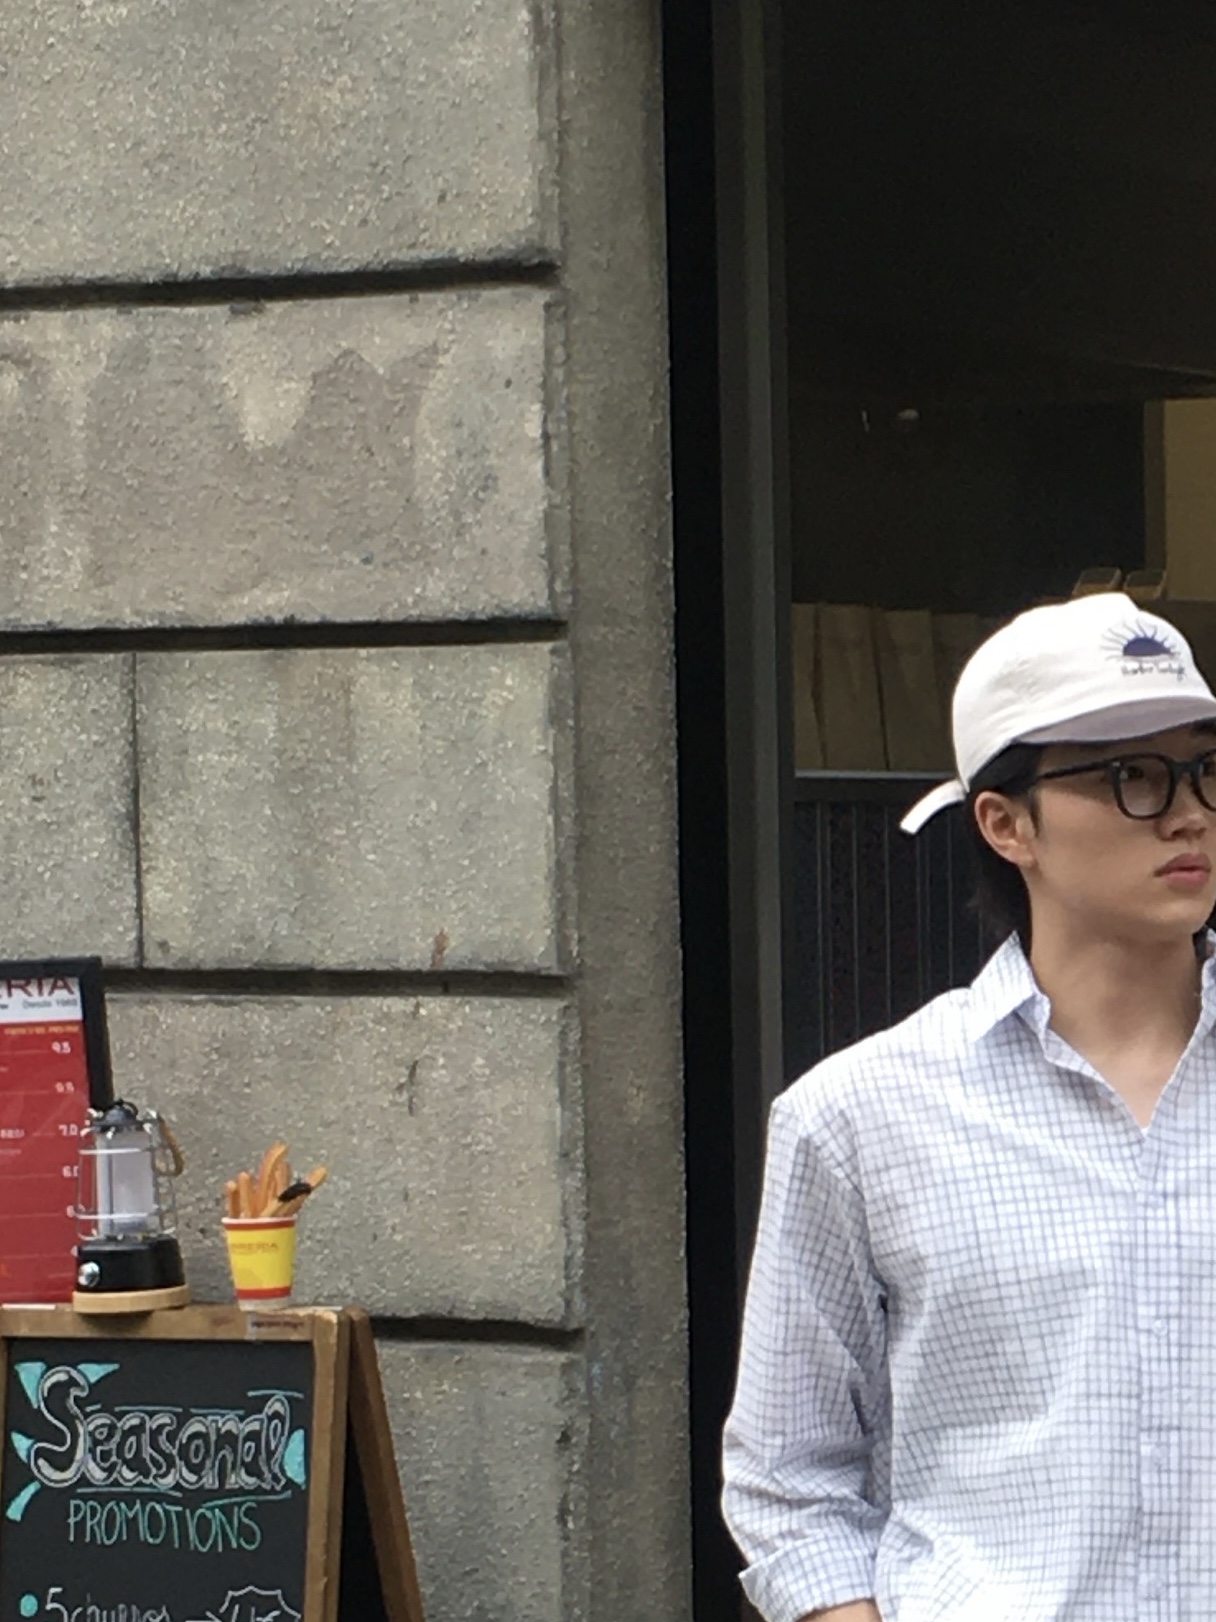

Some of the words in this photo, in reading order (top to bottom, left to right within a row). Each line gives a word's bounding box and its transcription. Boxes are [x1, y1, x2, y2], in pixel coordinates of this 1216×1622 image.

[0, 976, 75, 998] RIA
[30, 1365, 291, 1491] Seasonal
[67, 1499, 262, 1552] PROMOTIONS
